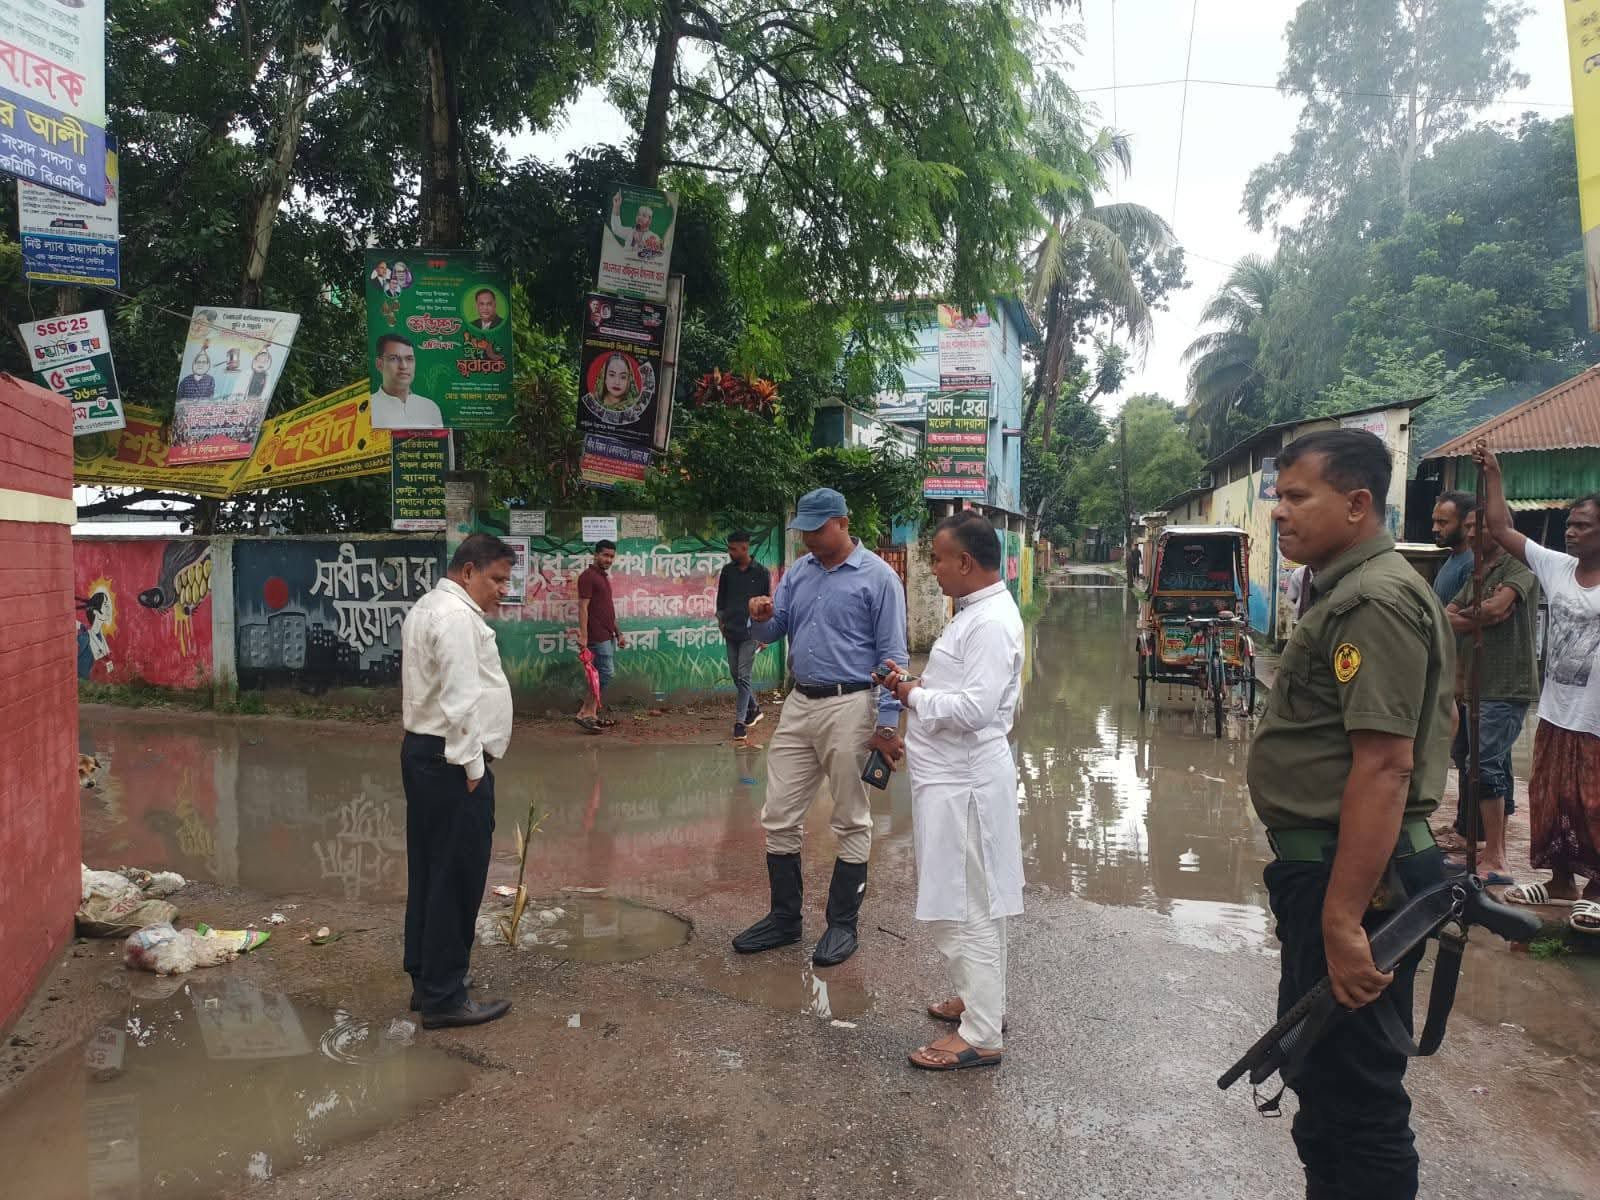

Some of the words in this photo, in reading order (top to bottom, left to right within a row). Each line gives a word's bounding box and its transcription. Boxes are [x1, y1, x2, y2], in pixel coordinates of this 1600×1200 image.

[24, 111, 88, 156] আলী
[2, 133, 37, 156] সংসদ
[40, 145, 73, 171] সদস্য
[78, 162, 87, 175] ও
[24, 237, 42, 250] নিউ
[282, 413, 357, 461] শহীদ
[928, 418, 952, 429] মডেল
[651, 544, 692, 577] দিয়ে
